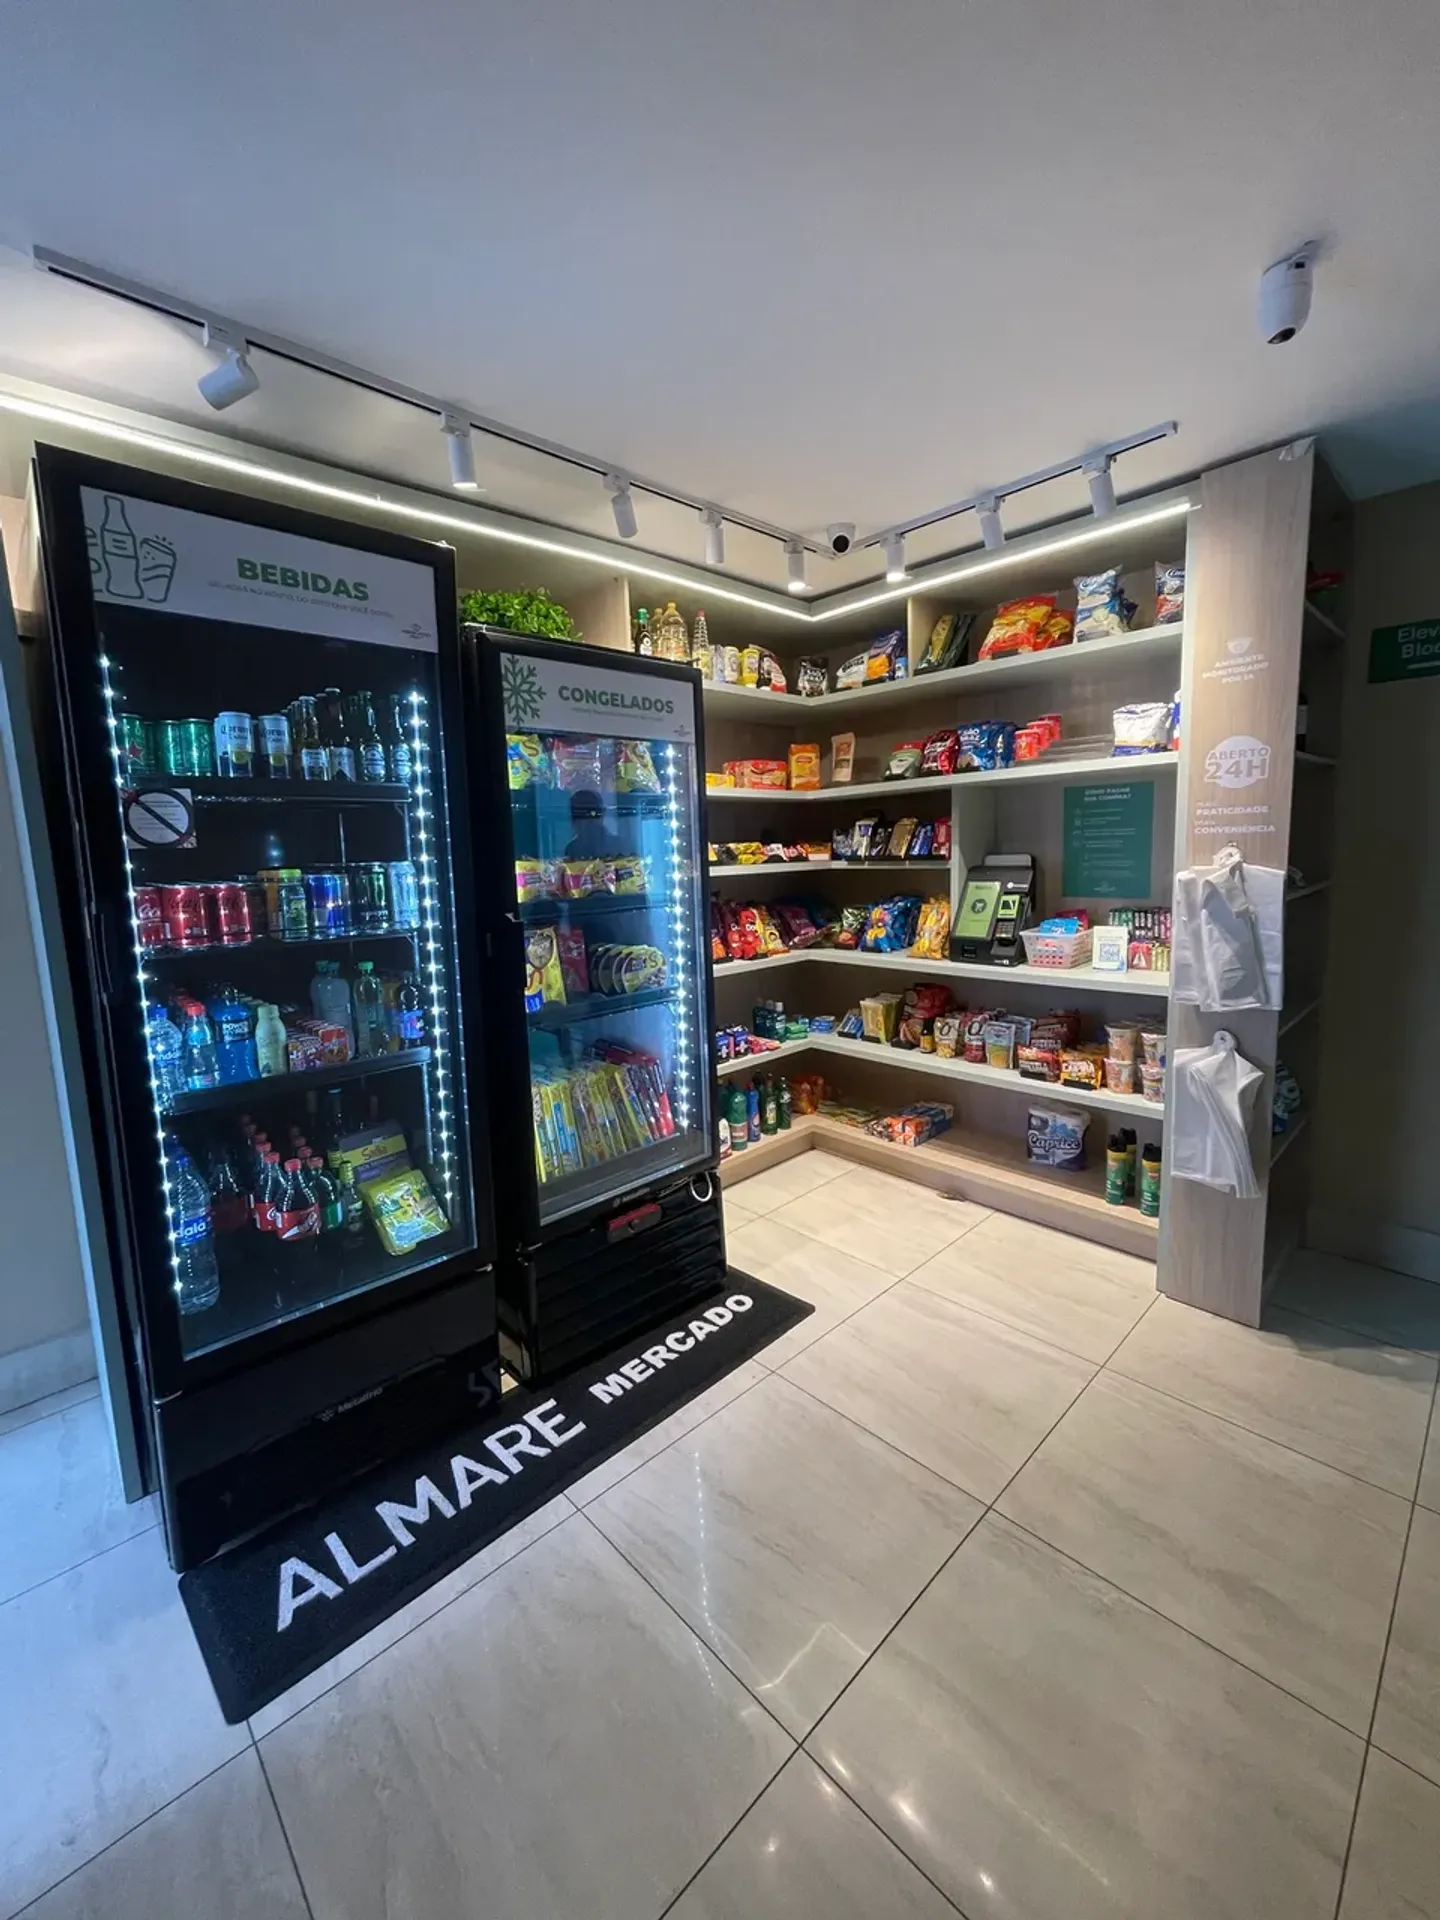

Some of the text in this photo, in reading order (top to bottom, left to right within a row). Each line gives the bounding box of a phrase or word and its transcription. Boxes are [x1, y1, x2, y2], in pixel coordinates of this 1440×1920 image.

[236, 557, 370, 602] BEBIDAS
[1398, 625, 1440, 643] Elev
[557, 685, 676, 715] CONGELADOS
[1207, 746, 1270, 761] ABERTO
[1205, 757, 1269, 780] 24H
[1195, 805, 1269, 816] PRATICIDADE
[1029, 1130, 1082, 1153] Caprice
[275, 1292, 755, 1633] ALMARE MERCADO
